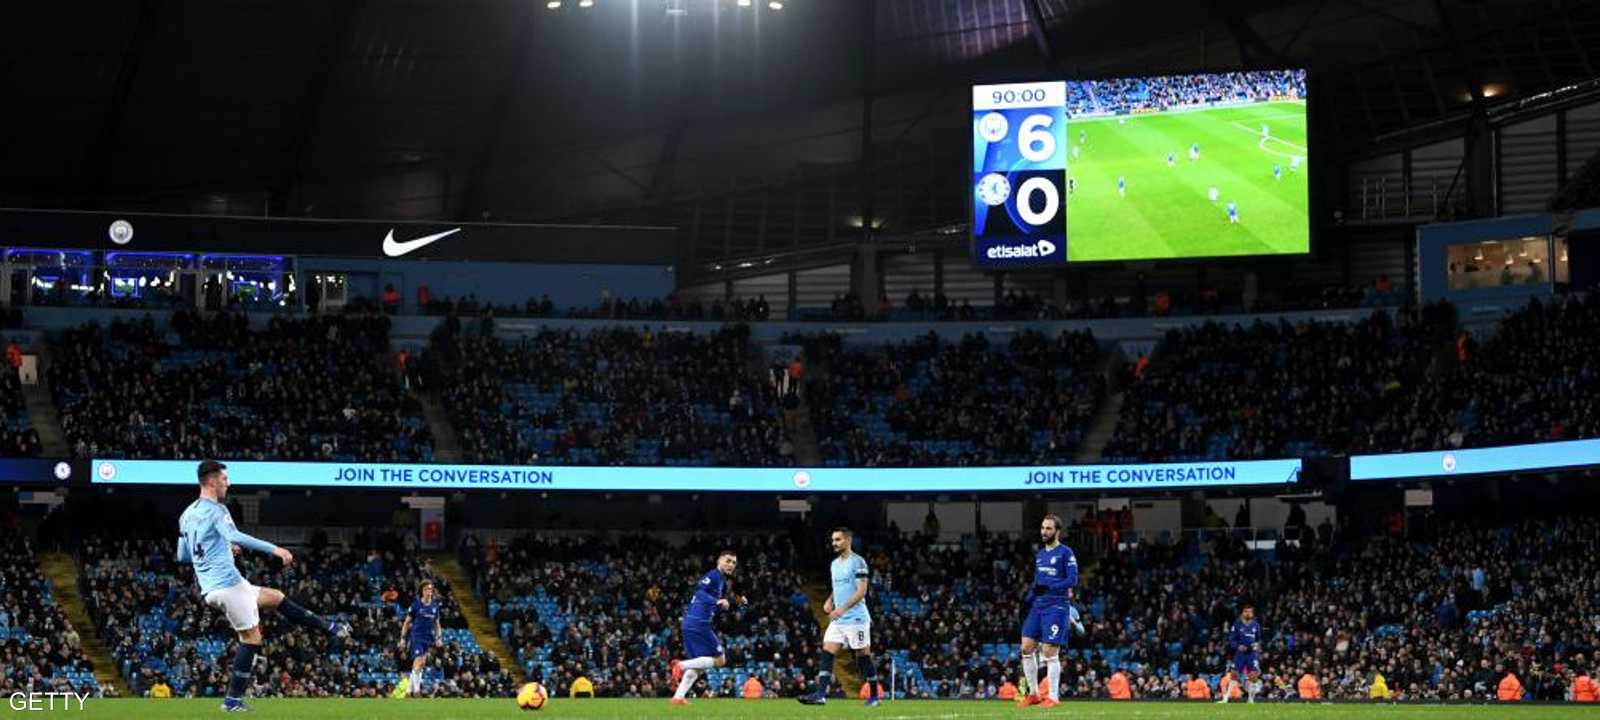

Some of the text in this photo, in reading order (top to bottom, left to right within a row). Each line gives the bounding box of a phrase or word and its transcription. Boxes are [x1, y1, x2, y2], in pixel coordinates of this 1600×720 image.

[992, 88, 1046, 104] 90:00
[1017, 113, 1057, 163] 6
[1016, 176, 1060, 226] 0
[986, 243, 1039, 259] etisalat
[335, 467, 553, 484] JOIN THE CONVERSATION
[1025, 466, 1236, 485] JOIN THE CONVERSATION
[1050, 623, 1060, 637] 9
